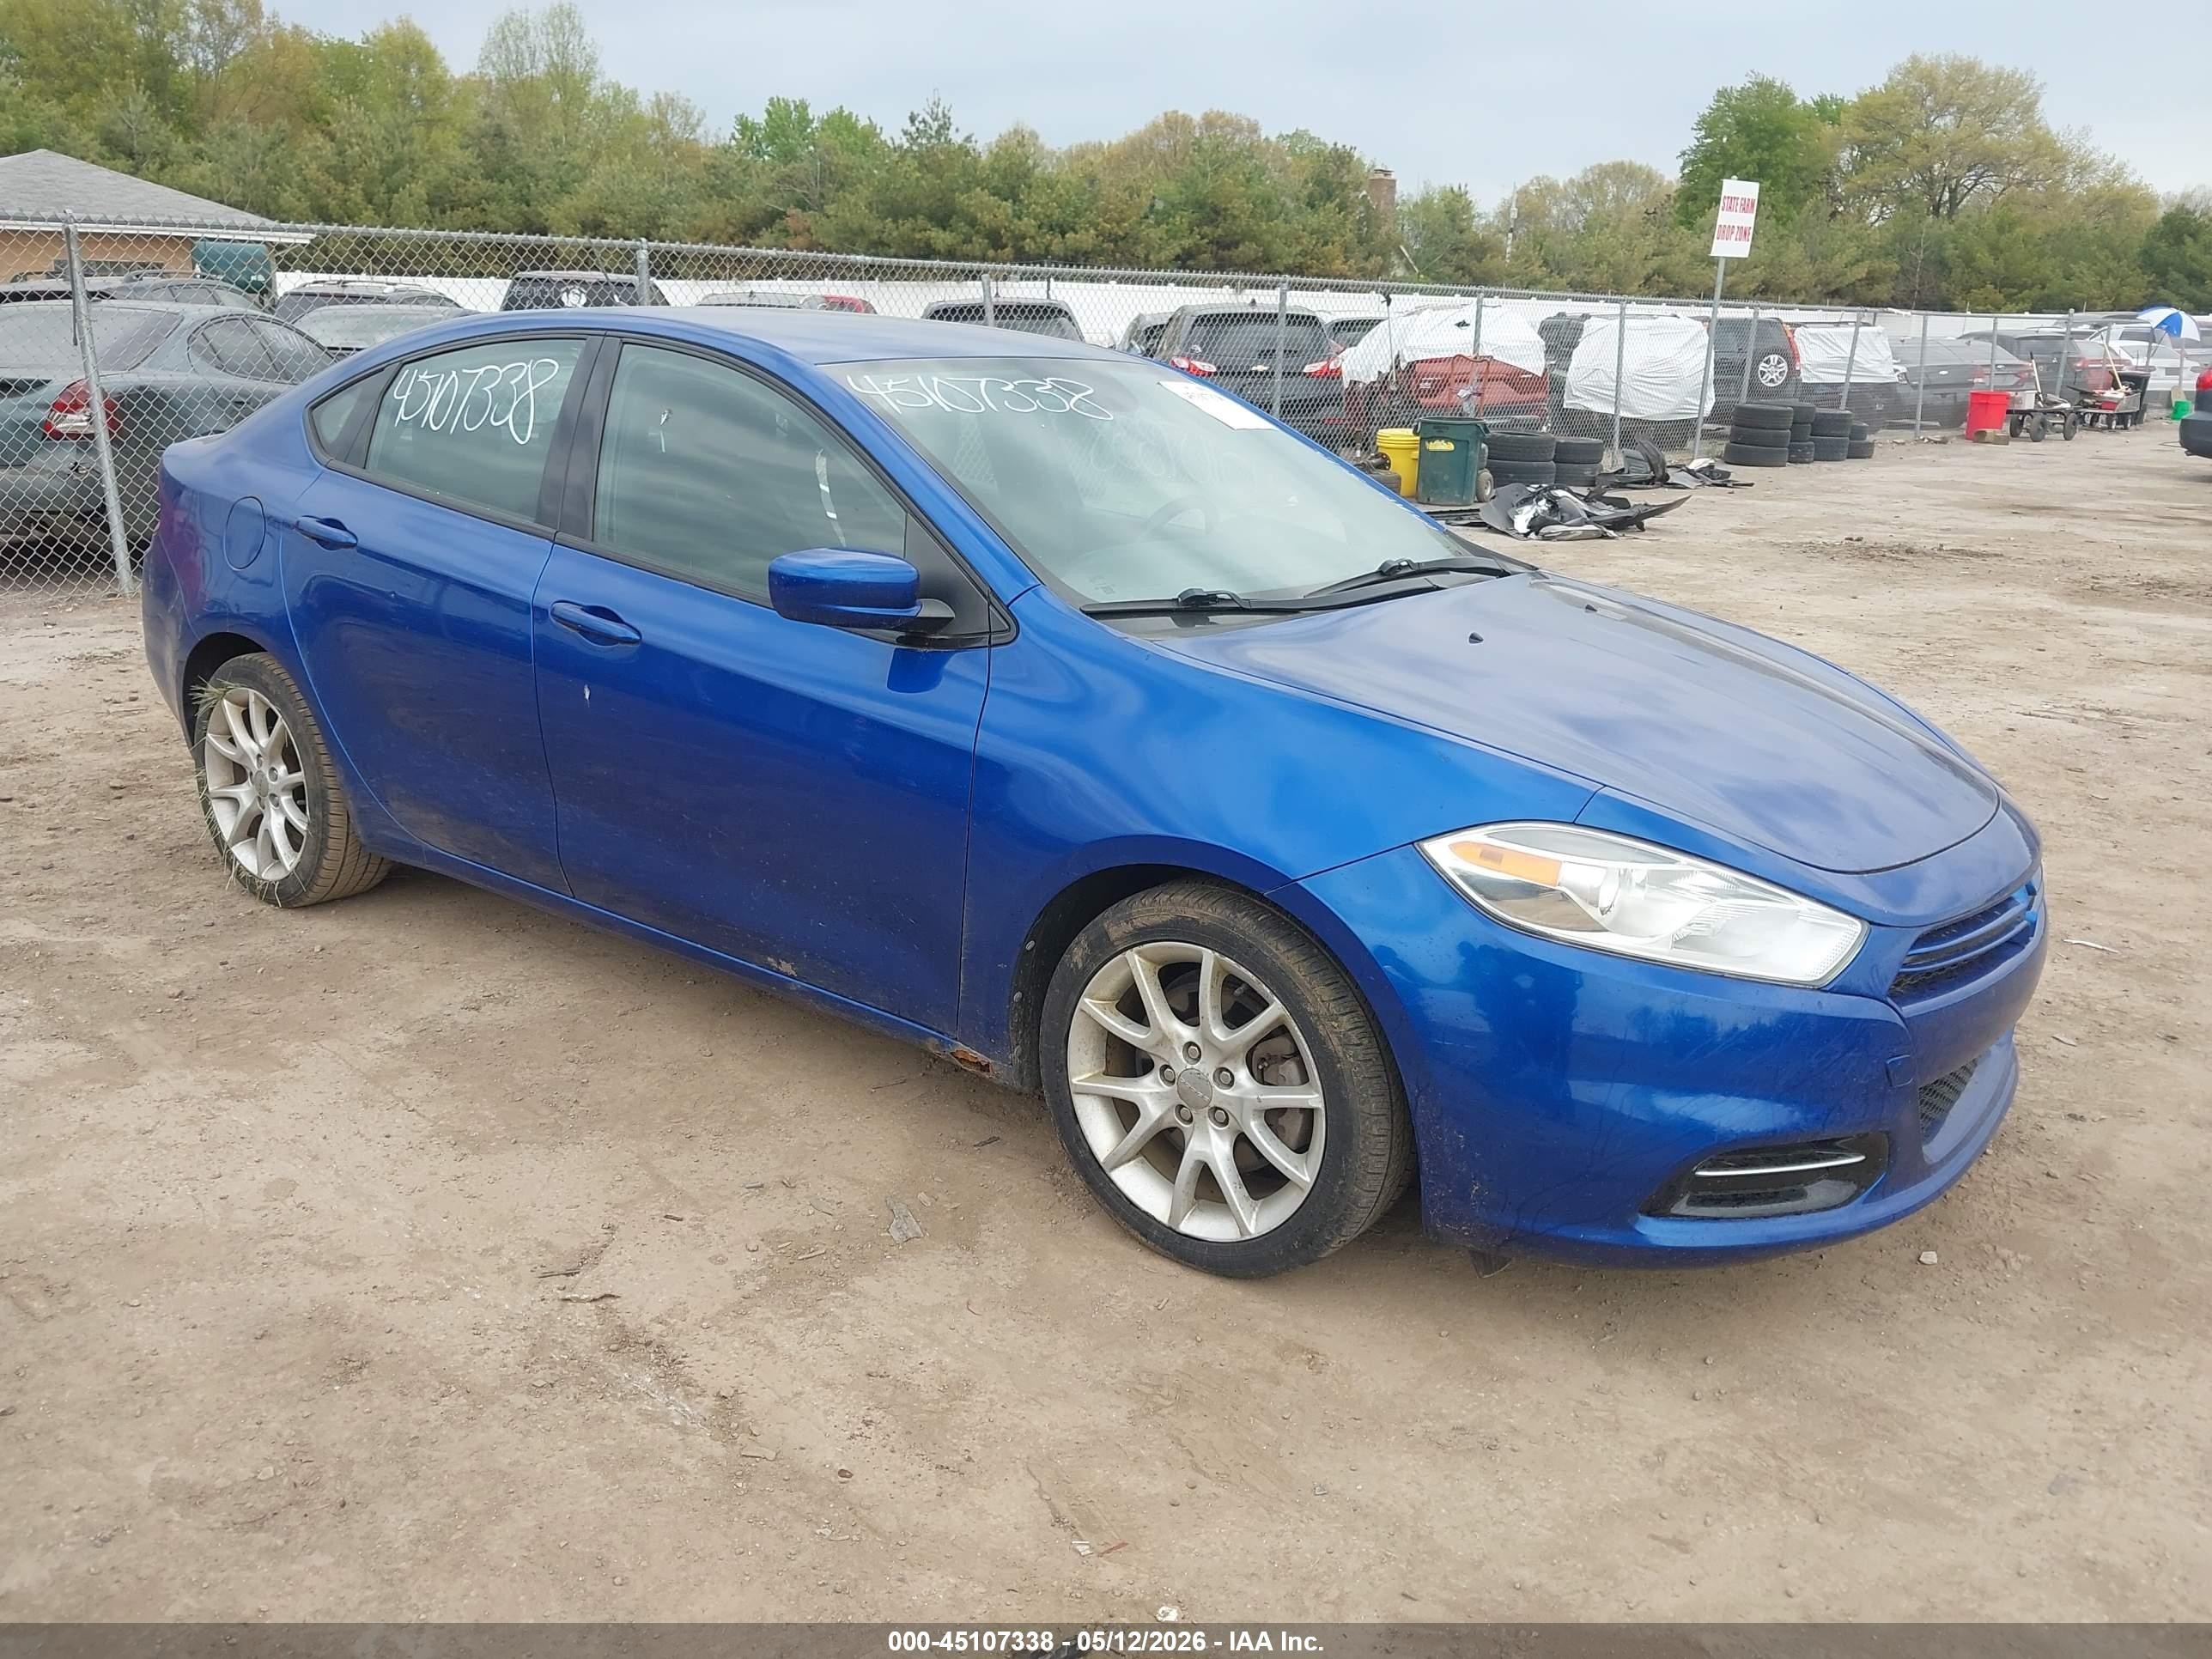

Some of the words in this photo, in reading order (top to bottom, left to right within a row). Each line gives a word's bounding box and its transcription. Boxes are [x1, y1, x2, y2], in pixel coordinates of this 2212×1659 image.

[1722, 196, 1740, 213] STATE
[1740, 198, 1755, 214] FARM
[1717, 224, 1735, 240] DROP
[1735, 226, 1752, 242] ZONE
[393, 358, 559, 445] 45107338
[846, 374, 1114, 421] 45107338
